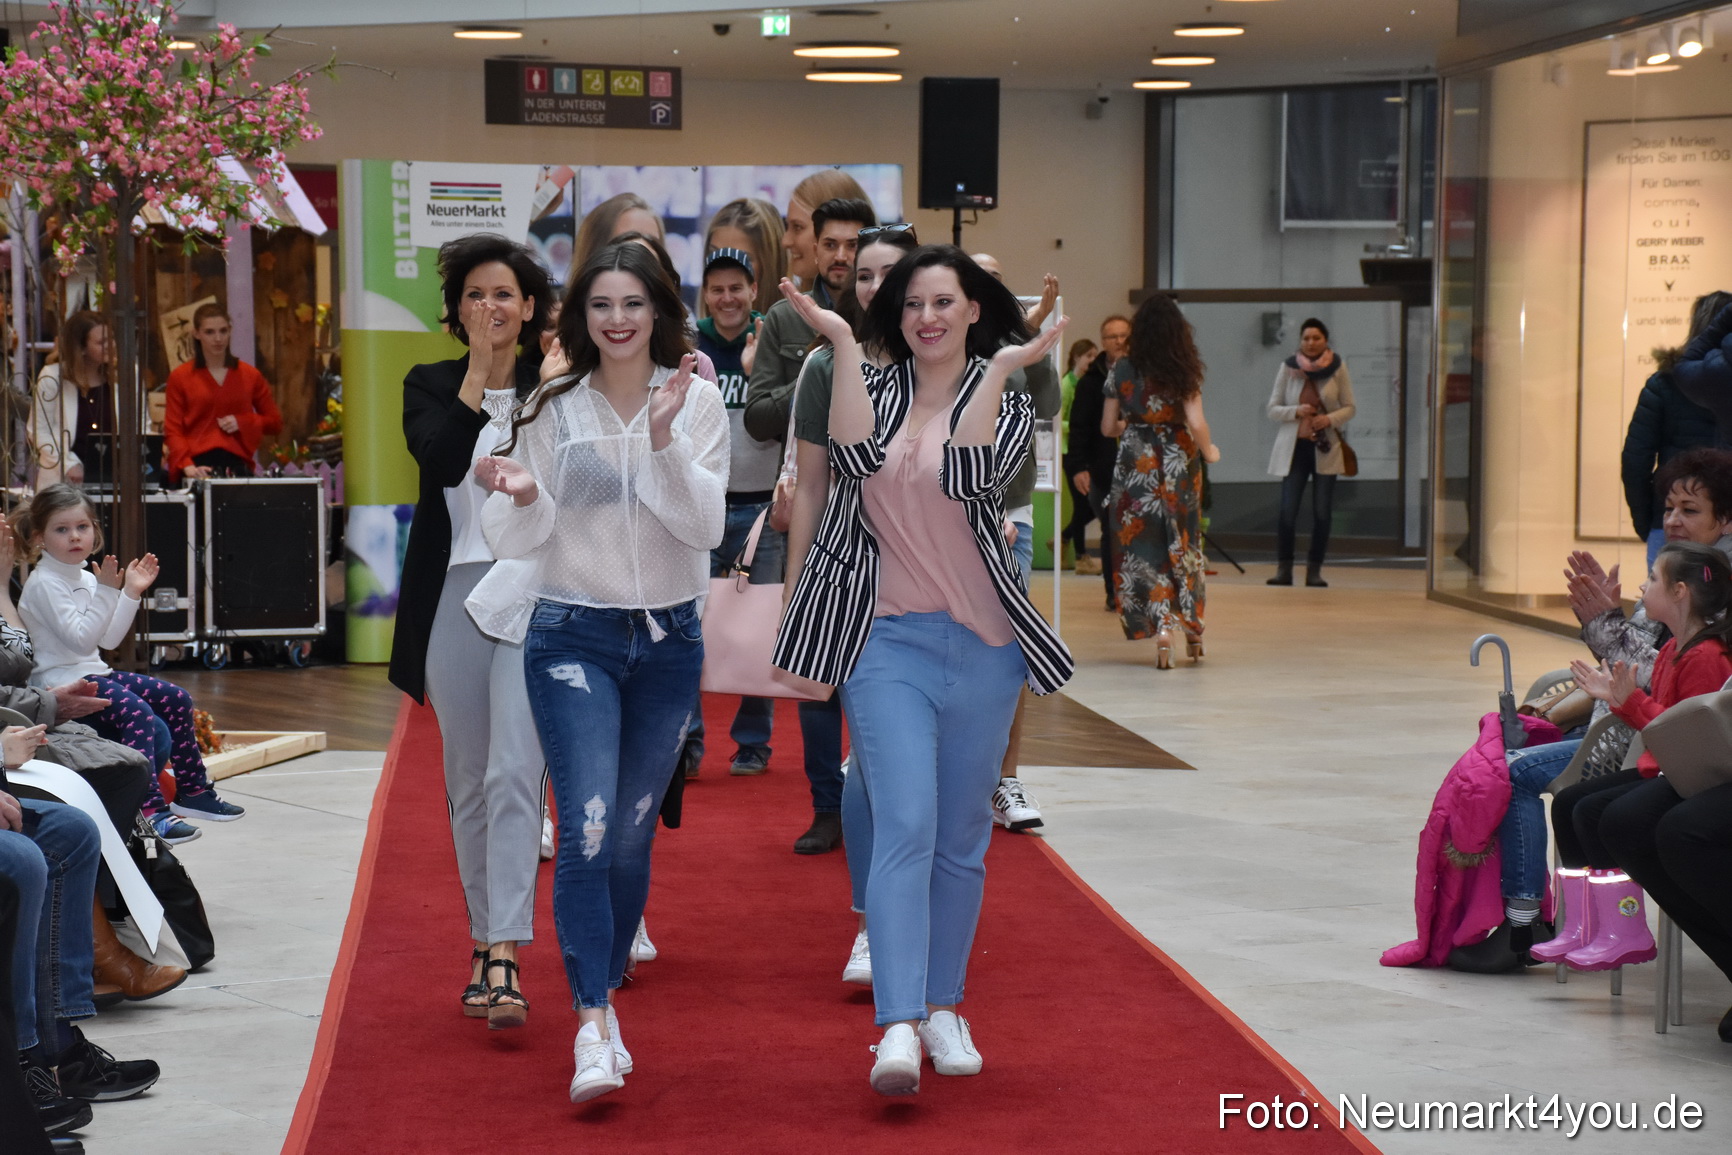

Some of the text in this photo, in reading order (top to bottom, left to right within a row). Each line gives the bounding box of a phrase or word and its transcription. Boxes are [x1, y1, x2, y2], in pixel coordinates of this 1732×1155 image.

[524, 98, 606, 111] IN DER UNTEREN
[524, 112, 606, 125] LADENSTRASSE
[1632, 136, 1716, 149] Diese Marken
[1616, 153, 1654, 165] finden
[1658, 151, 1677, 164] Sie
[1682, 152, 1697, 162] im
[426, 203, 507, 218] NeuerMarkt
[486, 221, 504, 229] Dach.
[1636, 236, 1705, 247] GERRY WEBER
[1649, 254, 1691, 266] BRAX
[1636, 316, 1656, 326] und
[1660, 315, 1683, 326] viele
